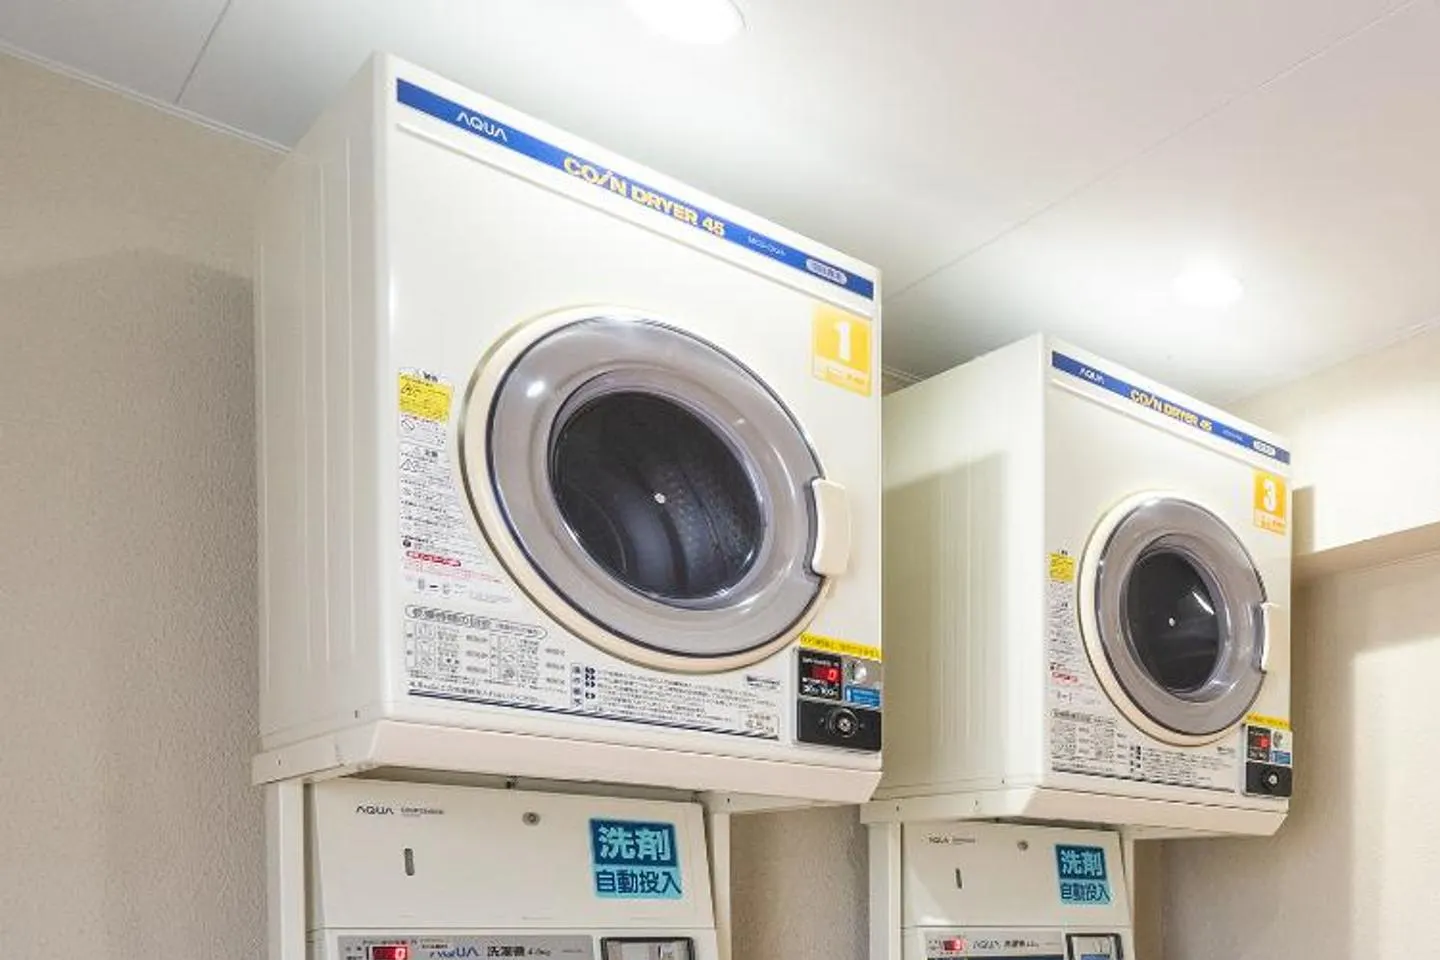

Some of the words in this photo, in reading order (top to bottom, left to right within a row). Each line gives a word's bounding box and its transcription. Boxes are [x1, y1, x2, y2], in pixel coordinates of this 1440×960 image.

[456, 111, 508, 142] AQUA
[563, 157, 627, 198] COIN
[631, 184, 698, 227] DRYER
[702, 217, 725, 237] 45
[834, 320, 852, 362] 1
[1262, 479, 1277, 511] 3
[356, 804, 395, 816] AQUA
[598, 824, 672, 862] 洗剤
[1060, 849, 1104, 877] 洗剤
[596, 869, 683, 894] 自動投入
